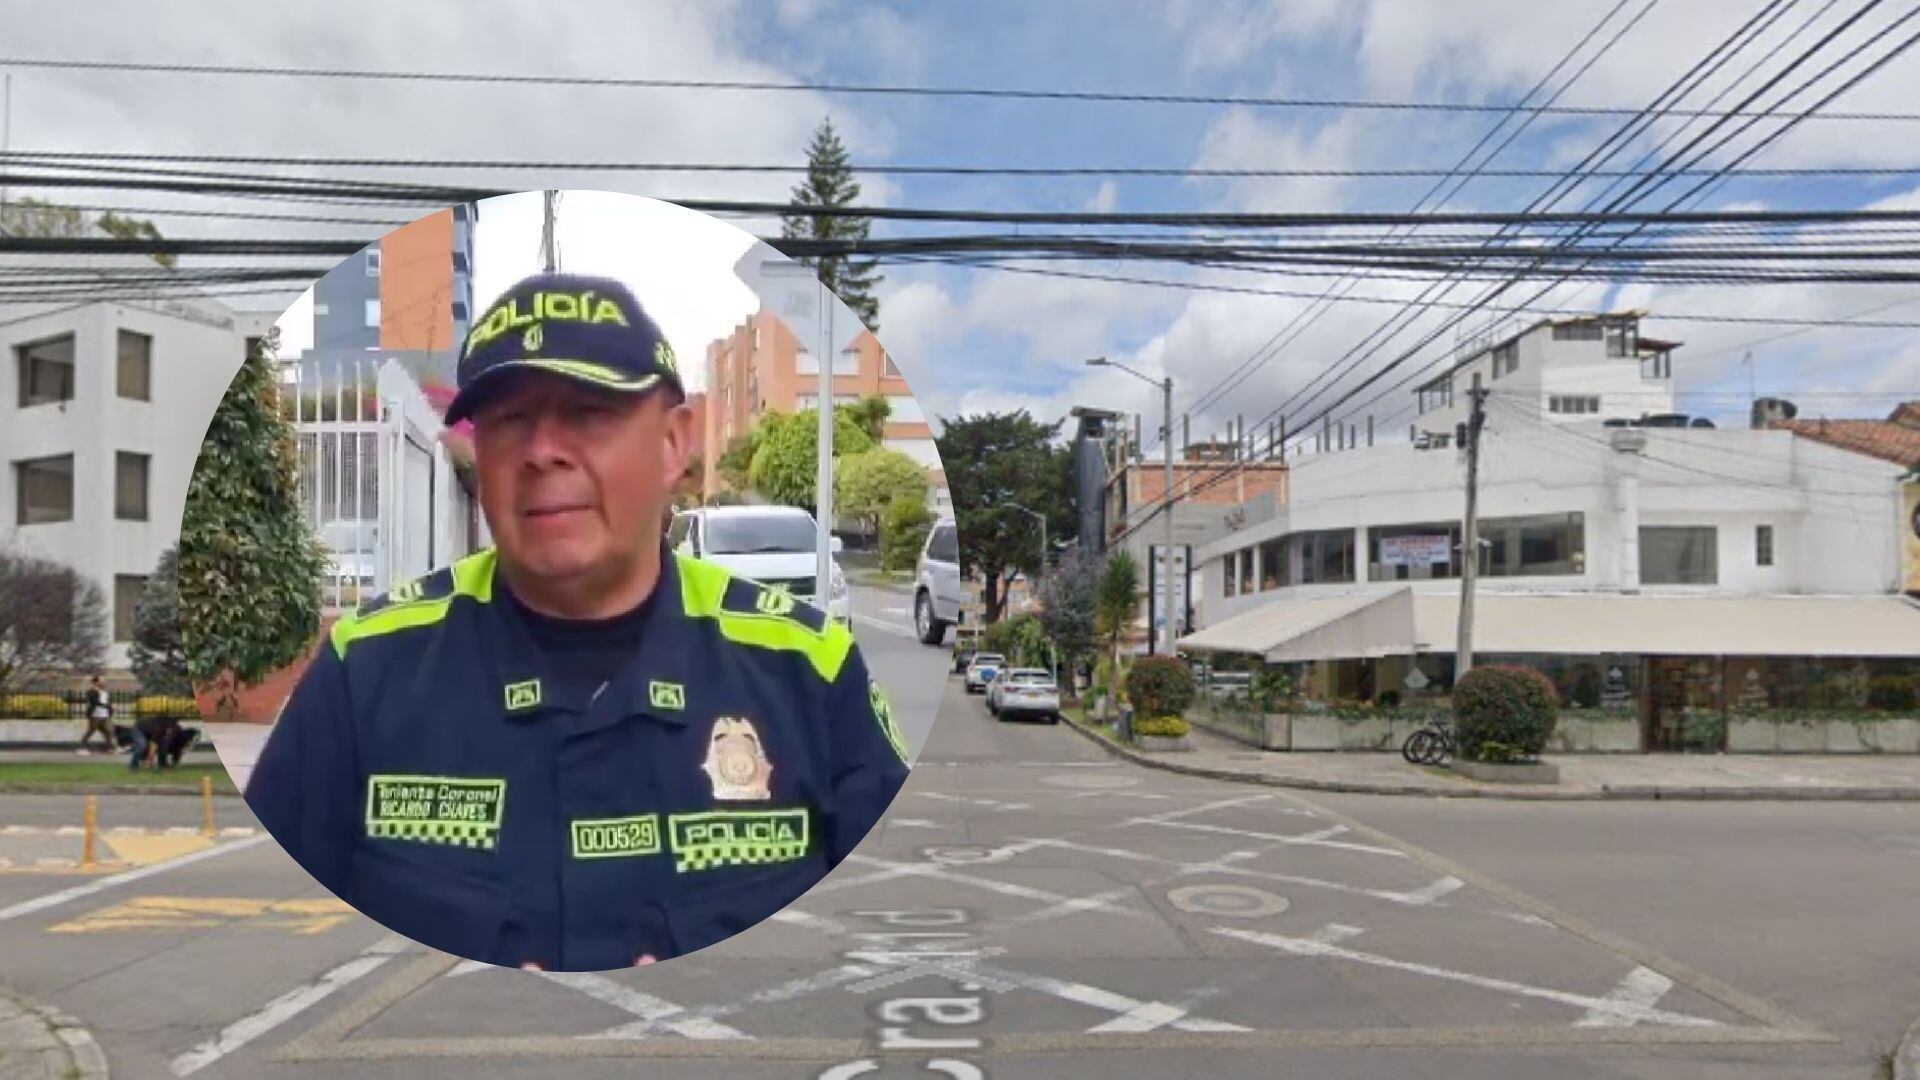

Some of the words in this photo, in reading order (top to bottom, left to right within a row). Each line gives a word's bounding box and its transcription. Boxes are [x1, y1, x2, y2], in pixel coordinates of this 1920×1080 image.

[438, 784, 498, 802] Coronel
[379, 801, 431, 817] RICARDO
[439, 803, 487, 819] CHAVES
[579, 822, 653, 851] 000529
